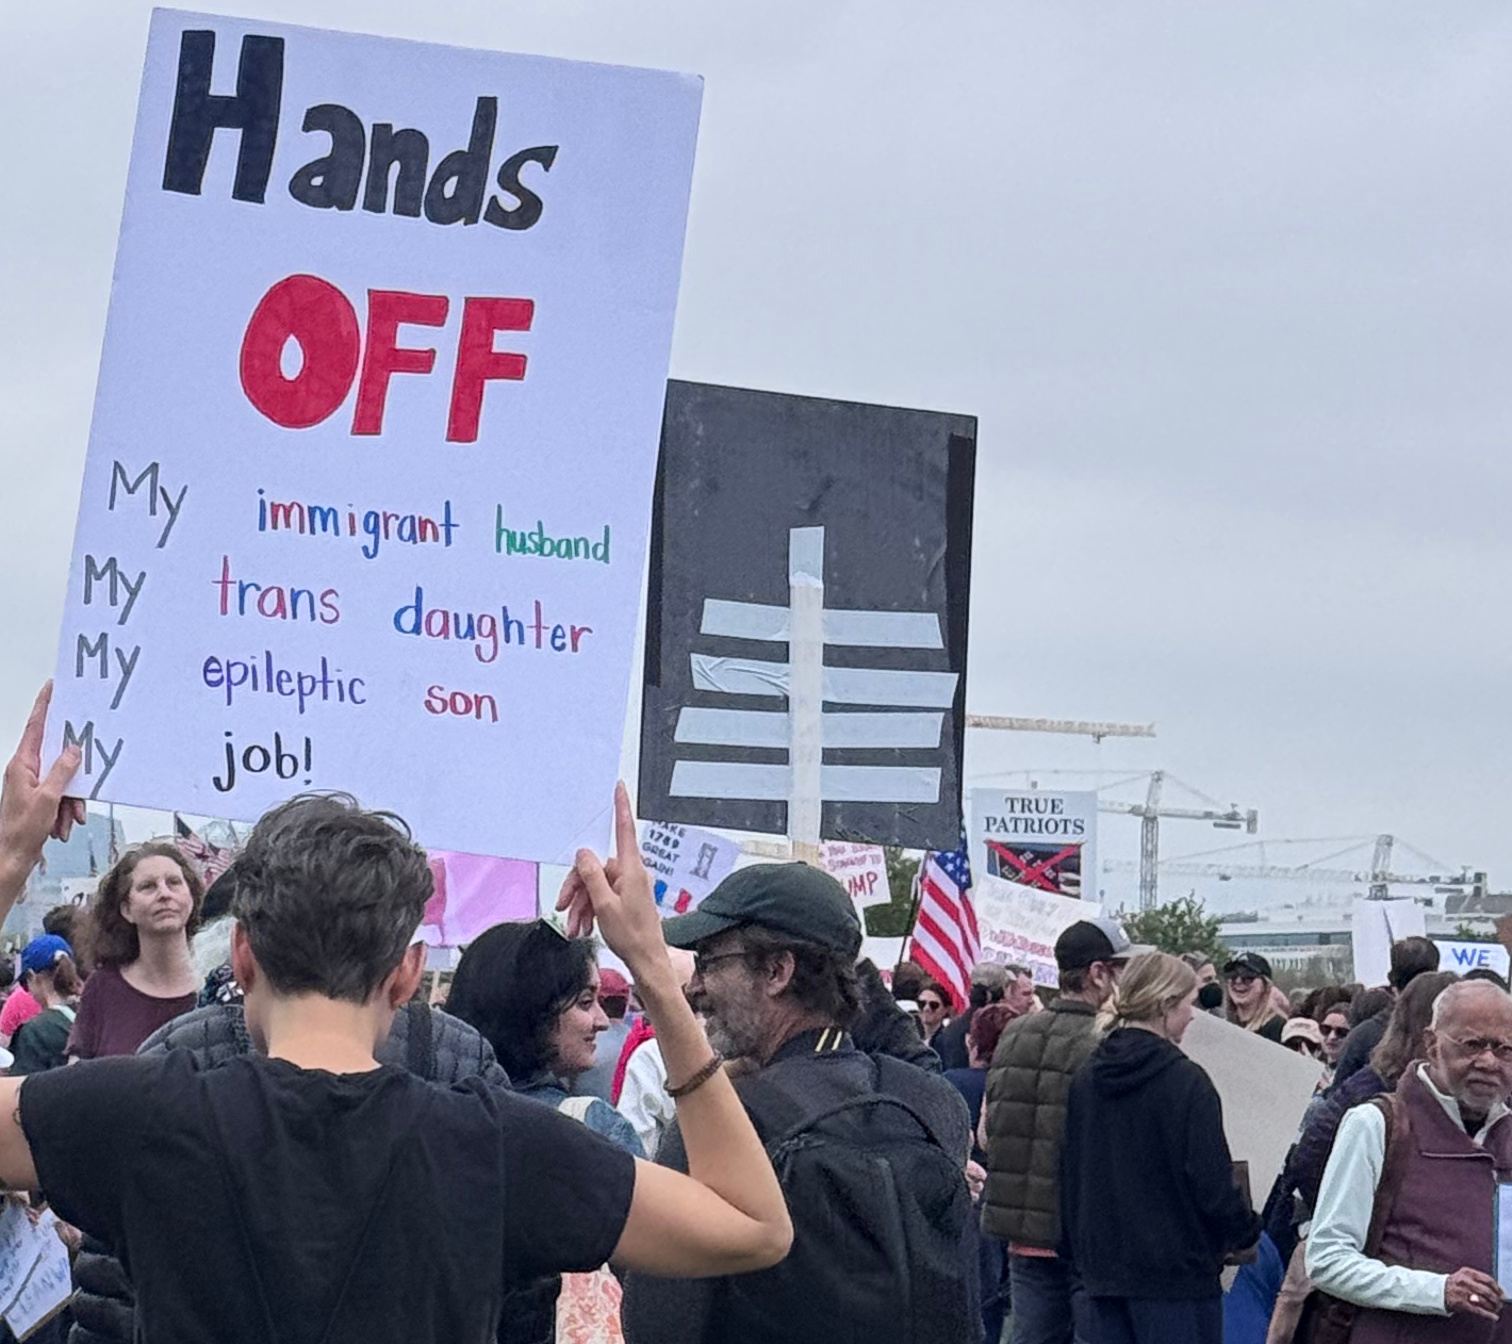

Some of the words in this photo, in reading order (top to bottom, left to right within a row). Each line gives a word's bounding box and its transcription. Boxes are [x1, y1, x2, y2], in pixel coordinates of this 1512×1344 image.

[162, 30, 559, 230] Hands
[240, 273, 535, 443] OFF
[108, 460, 188, 548] My
[257, 488, 460, 560] immigrant
[495, 503, 612, 566] husband
[82, 554, 147, 625] My
[212, 556, 341, 624] trans
[393, 587, 594, 663] daughter
[75, 632, 142, 709] My
[203, 649, 366, 716] epileptic
[424, 685, 500, 725] son
[63, 720, 125, 801] My
[213, 731, 314, 794] job!
[984, 815, 1085, 835] PATRIOTS
[1005, 797, 1064, 815] TRUE
[641, 855, 675, 876] GAIN!
[642, 842, 680, 863] GREAT
[1452, 947, 1491, 967] WE
